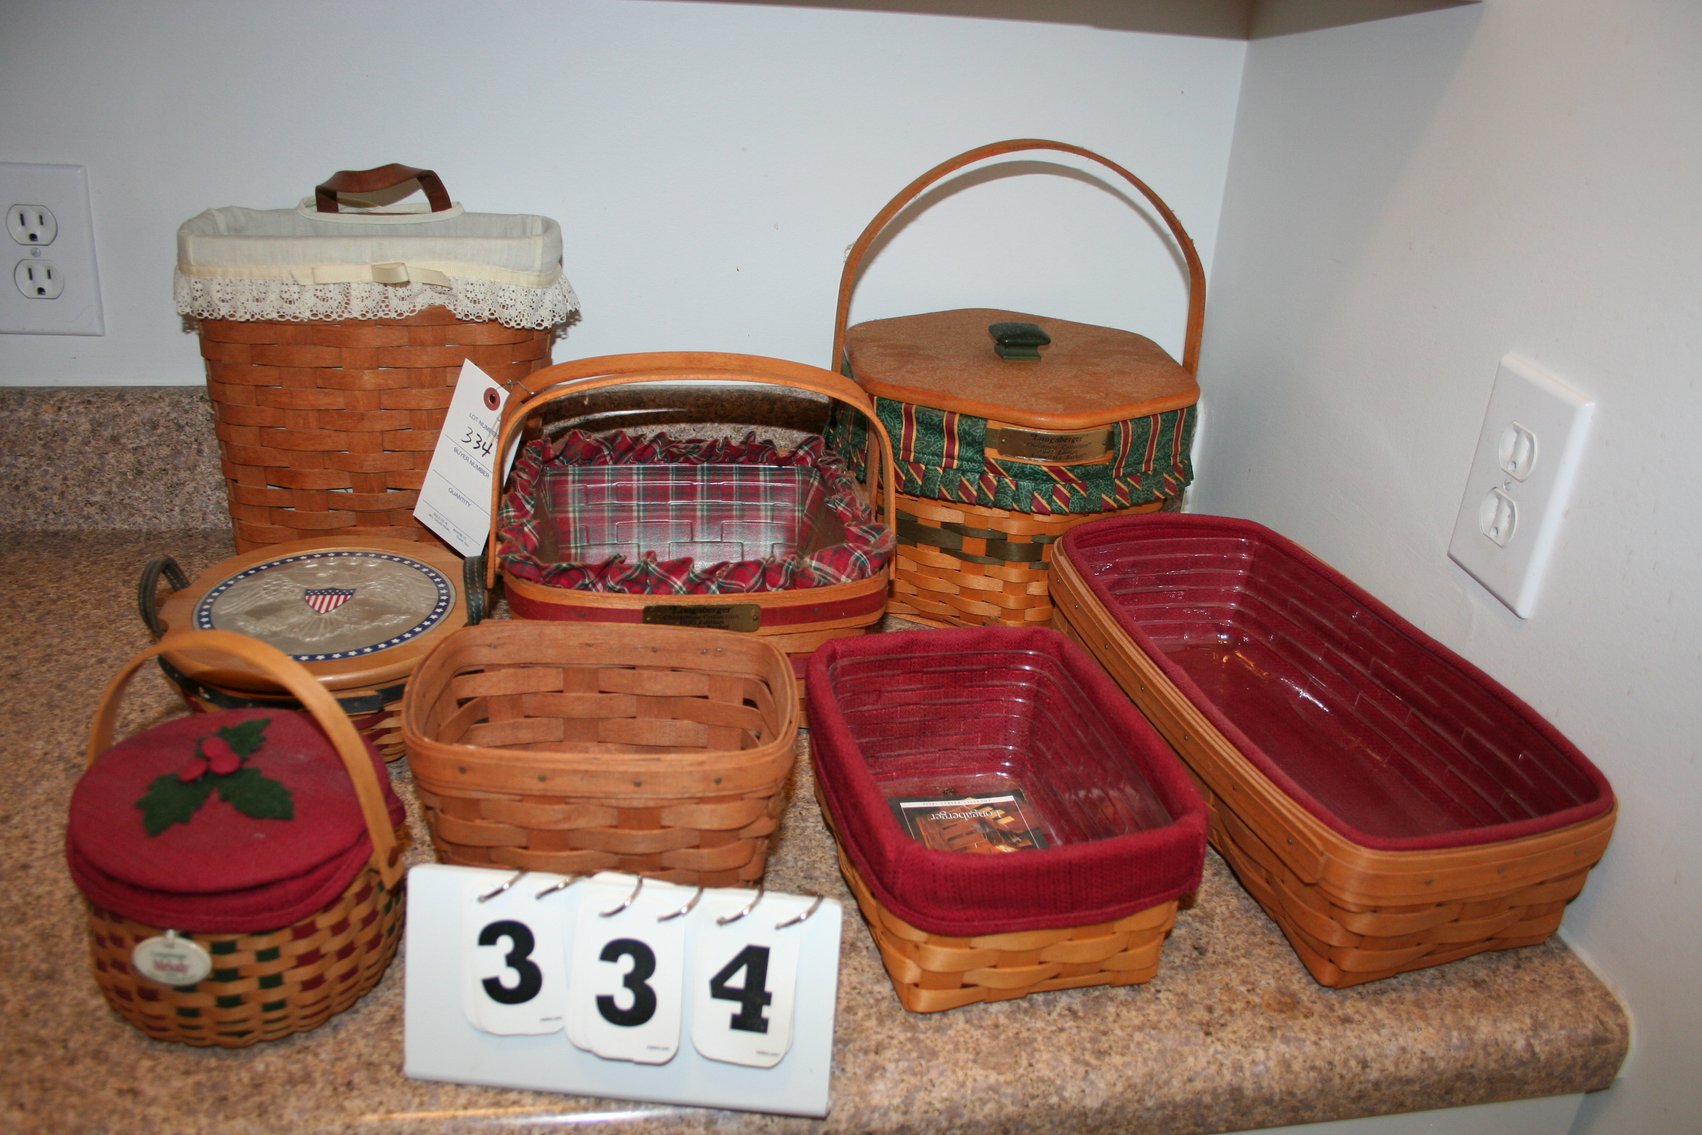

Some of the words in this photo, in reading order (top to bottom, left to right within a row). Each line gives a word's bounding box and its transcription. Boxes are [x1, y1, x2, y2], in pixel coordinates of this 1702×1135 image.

[469, 413, 479, 422] LOT
[461, 426, 493, 457] 334
[453, 447, 470, 462] BUYER
[469, 460, 490, 478] NUMBER
[448, 487, 472, 508] QUANTITY
[930, 809, 1002, 821] Longaberger
